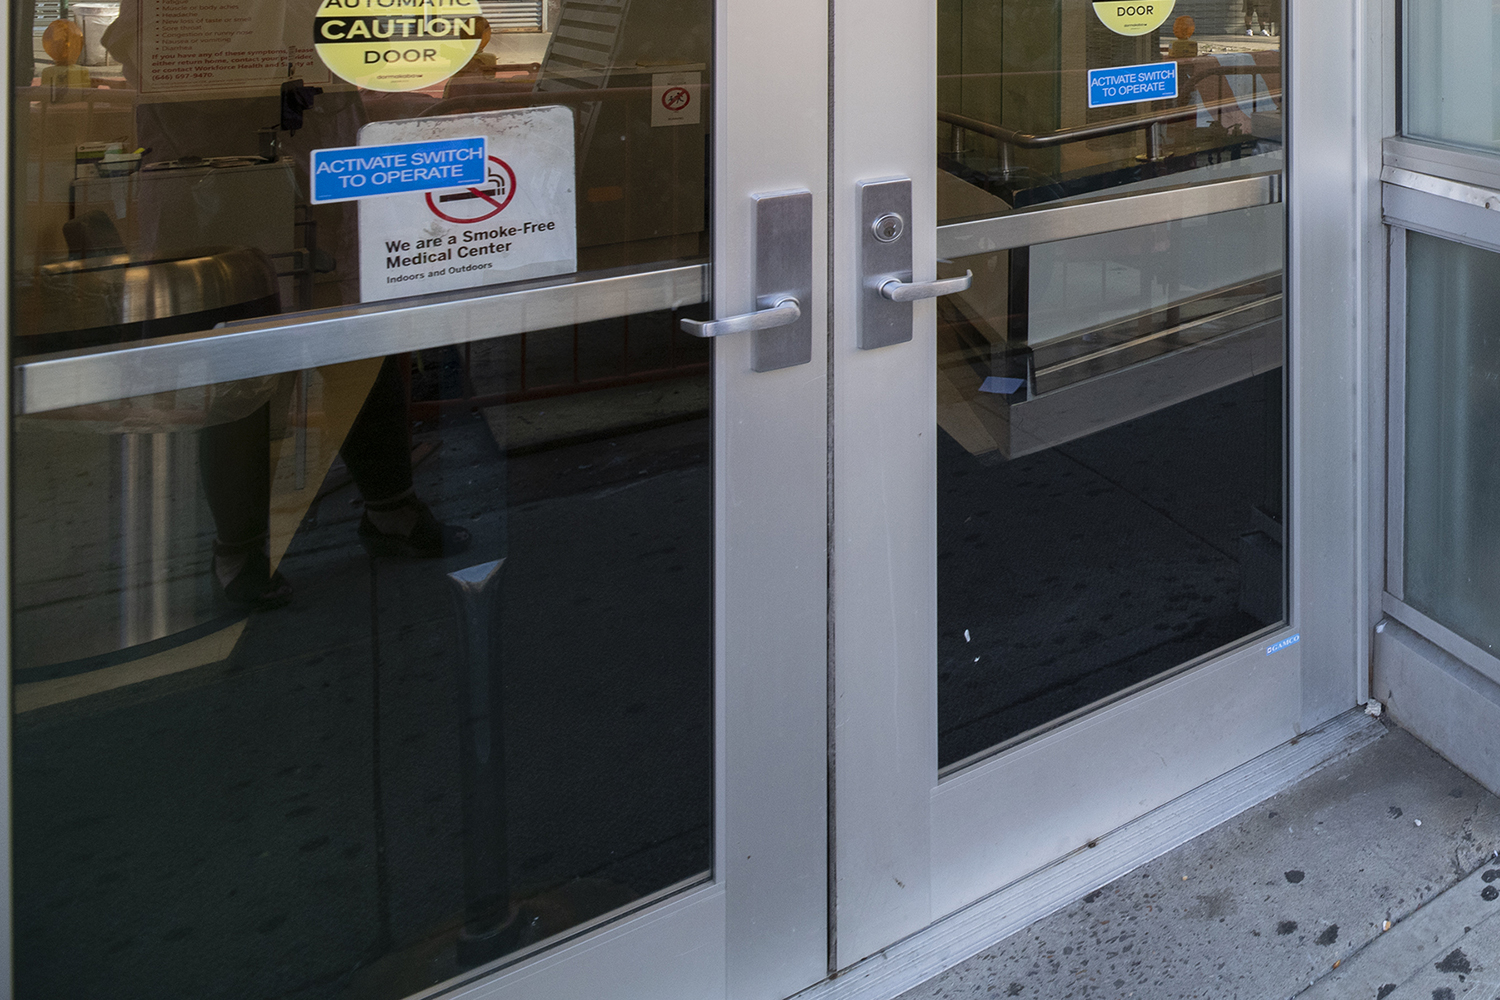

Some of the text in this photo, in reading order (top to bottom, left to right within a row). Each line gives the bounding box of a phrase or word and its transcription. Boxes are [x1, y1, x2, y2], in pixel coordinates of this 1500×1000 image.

[1117, 5, 1154, 17] DOOR
[320, 17, 477, 41] CAUTION
[198, 52, 213, 60] any
[364, 48, 437, 65] DOOR
[1090, 68, 1175, 88] ACTIVATE SWITCH
[1102, 82, 1166, 98] TO OPERATE
[316, 146, 483, 176] ACTIVATE SWITCH
[339, 164, 464, 188] TO OPERATE
[385, 220, 556, 254] We are a Smoke-Free
[386, 240, 513, 270] Medical Center
[386, 261, 493, 285] Indoors and Outdoors
[1272, 635, 1300, 652] GAMCO
